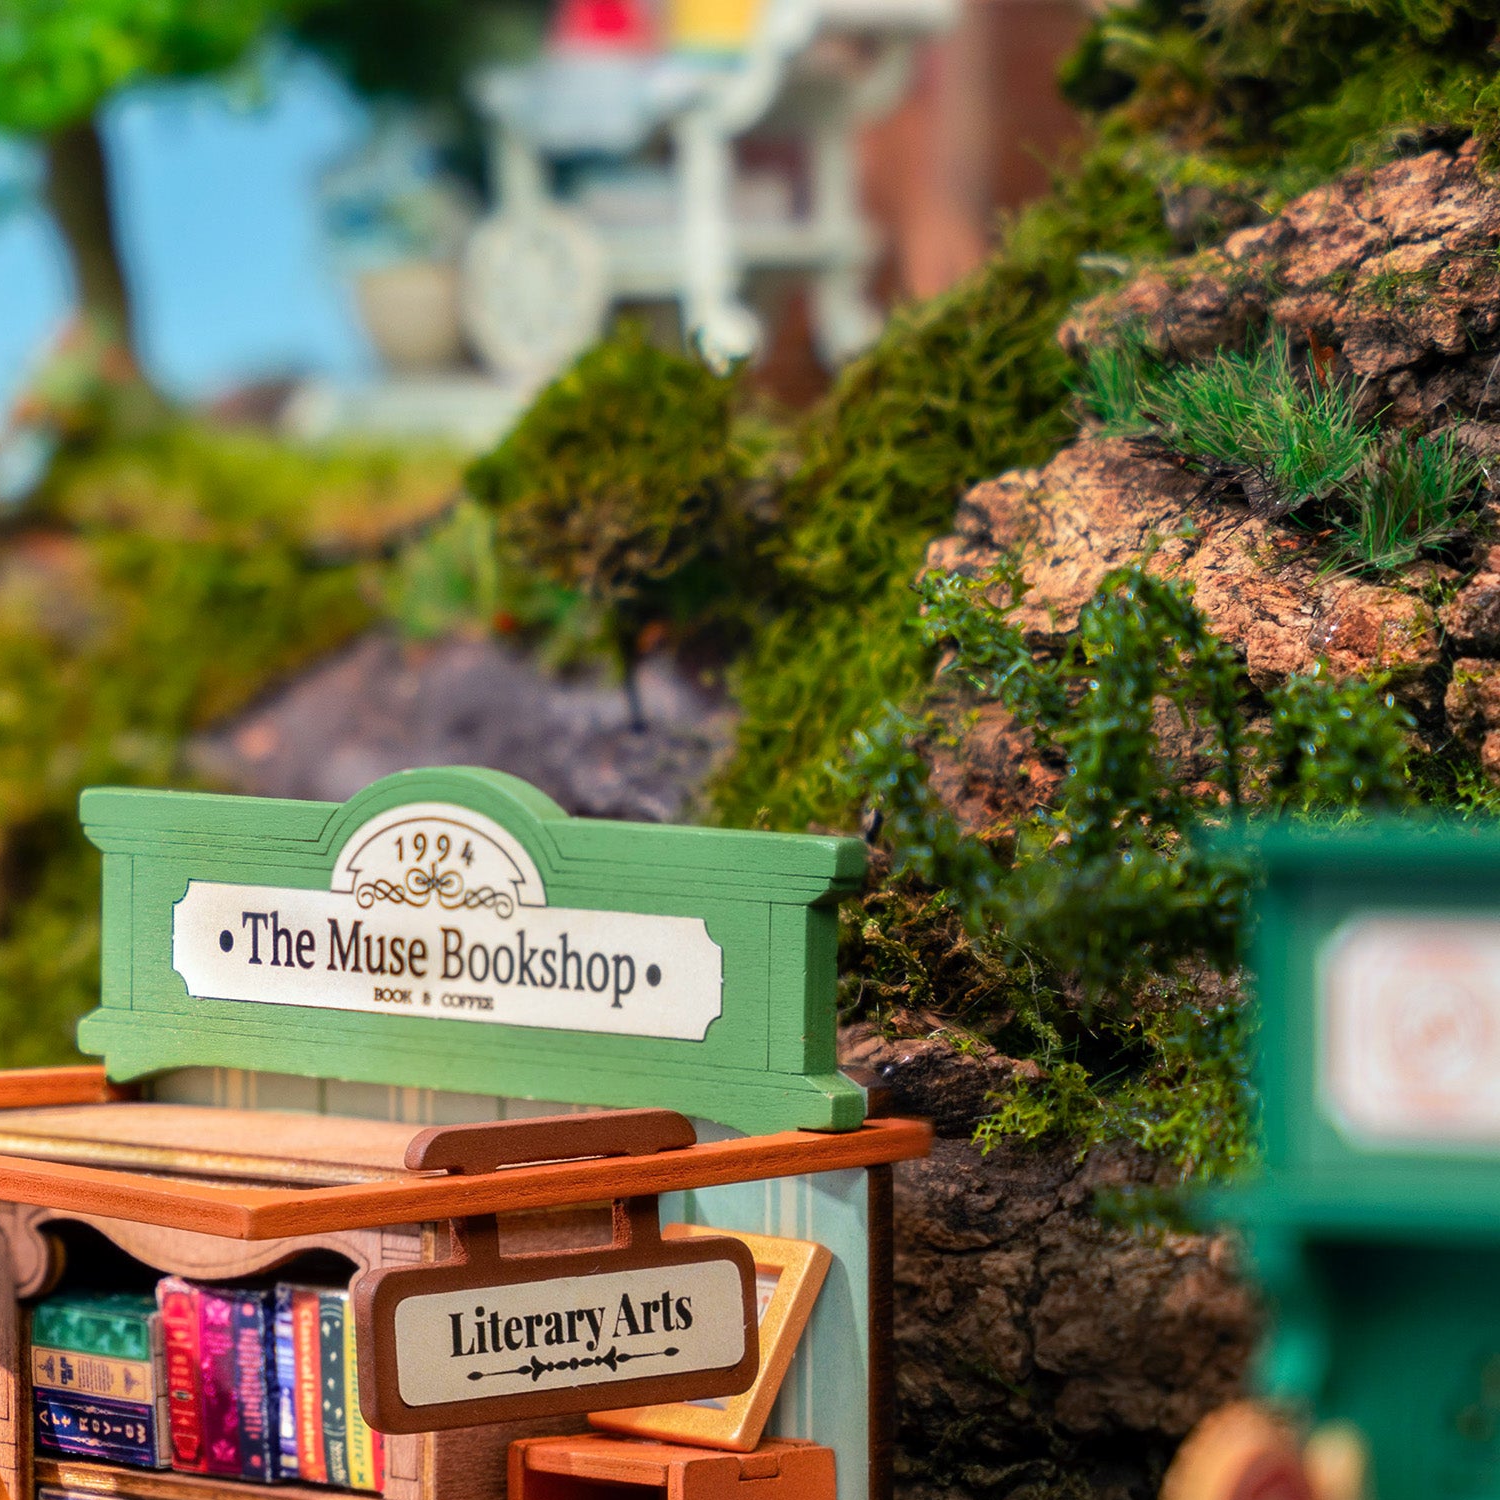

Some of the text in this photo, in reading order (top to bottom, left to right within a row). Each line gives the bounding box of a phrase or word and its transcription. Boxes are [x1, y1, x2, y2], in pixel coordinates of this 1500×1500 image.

[394, 832, 474, 867] 1994
[242, 911, 636, 1008] The Muse Bookshop
[373, 986, 412, 1005] BOOK
[441, 993, 494, 1011] COFFEE
[448, 1290, 694, 1358] Literary Arts
